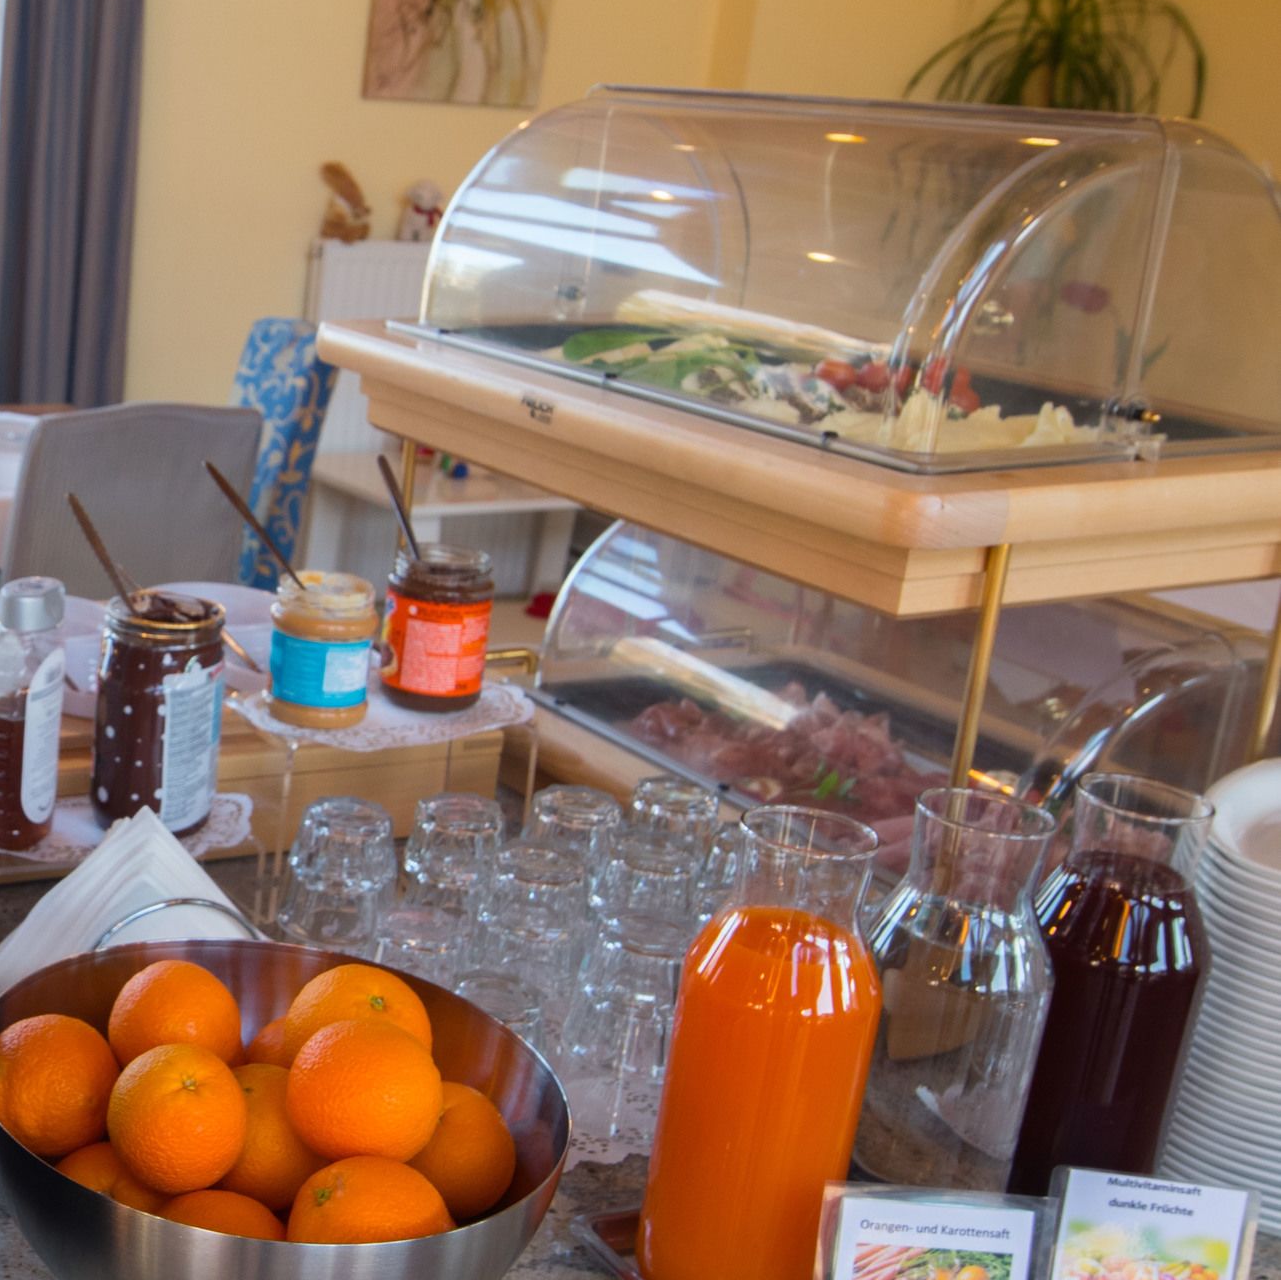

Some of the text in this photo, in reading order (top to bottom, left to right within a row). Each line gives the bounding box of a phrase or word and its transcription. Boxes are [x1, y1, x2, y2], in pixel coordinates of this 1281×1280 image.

[1106, 1177, 1202, 1196] Multivitaminsaft
[1108, 1198, 1195, 1216] dunkle Früchte
[860, 1219, 1011, 1240] Orangen- und Karottensaft
